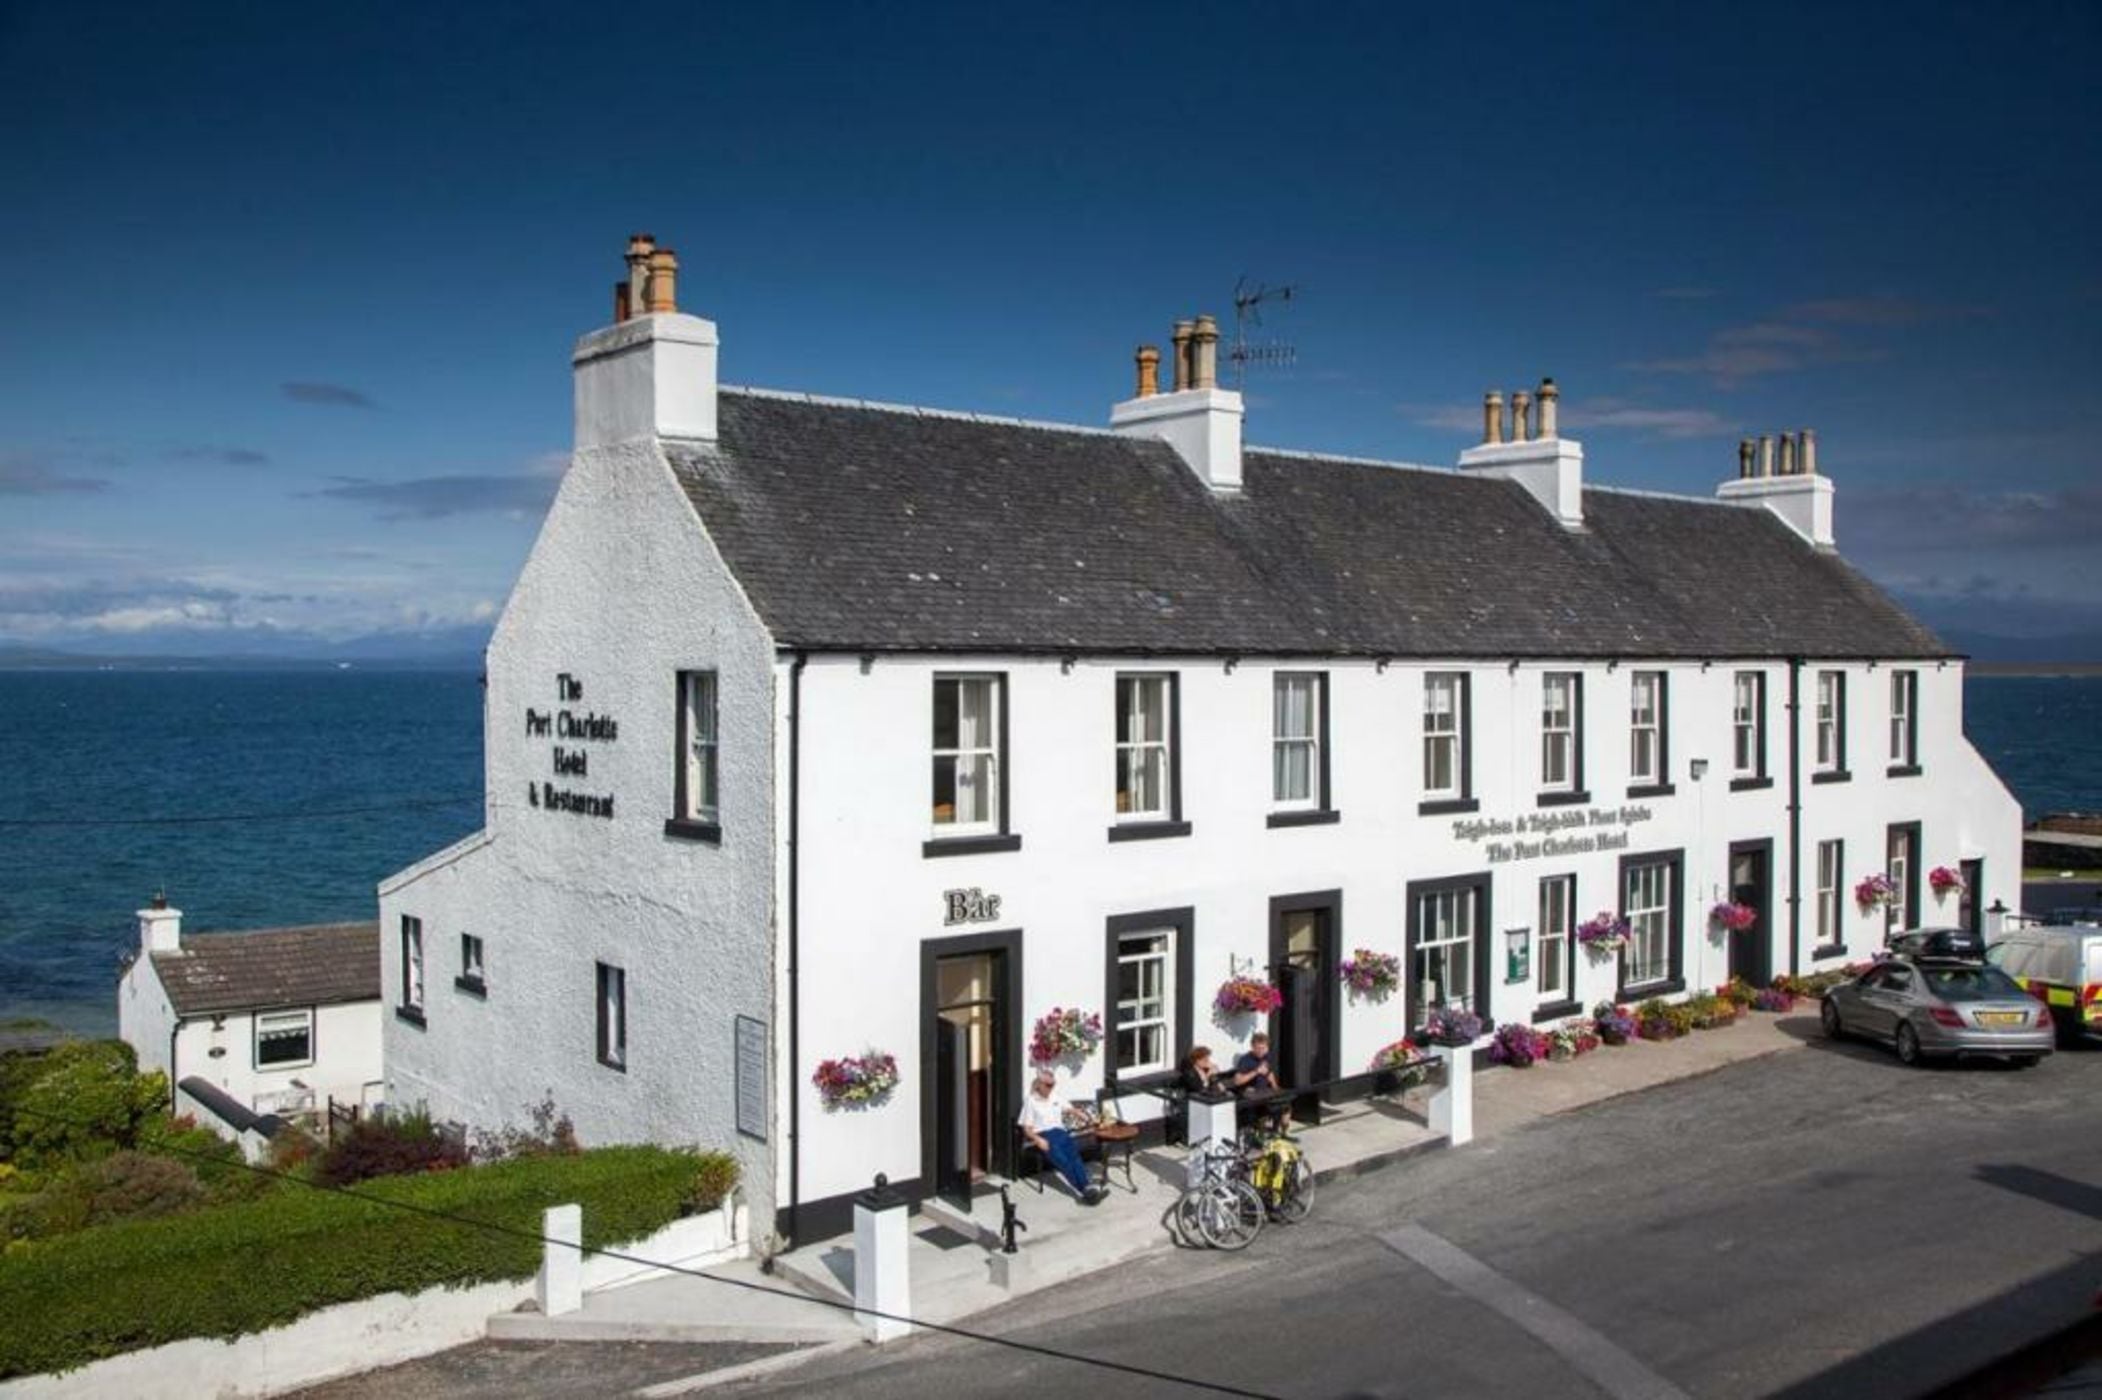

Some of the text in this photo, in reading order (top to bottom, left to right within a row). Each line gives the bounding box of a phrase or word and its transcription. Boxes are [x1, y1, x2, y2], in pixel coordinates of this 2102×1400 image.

[557, 672, 583, 701] The
[526, 708, 618, 742] Port Charlotte
[553, 746, 588, 778] Hotel
[544, 782, 614, 820] Restaurant
[1486, 841, 1512, 863] The
[943, 887, 1001, 926] Bar
